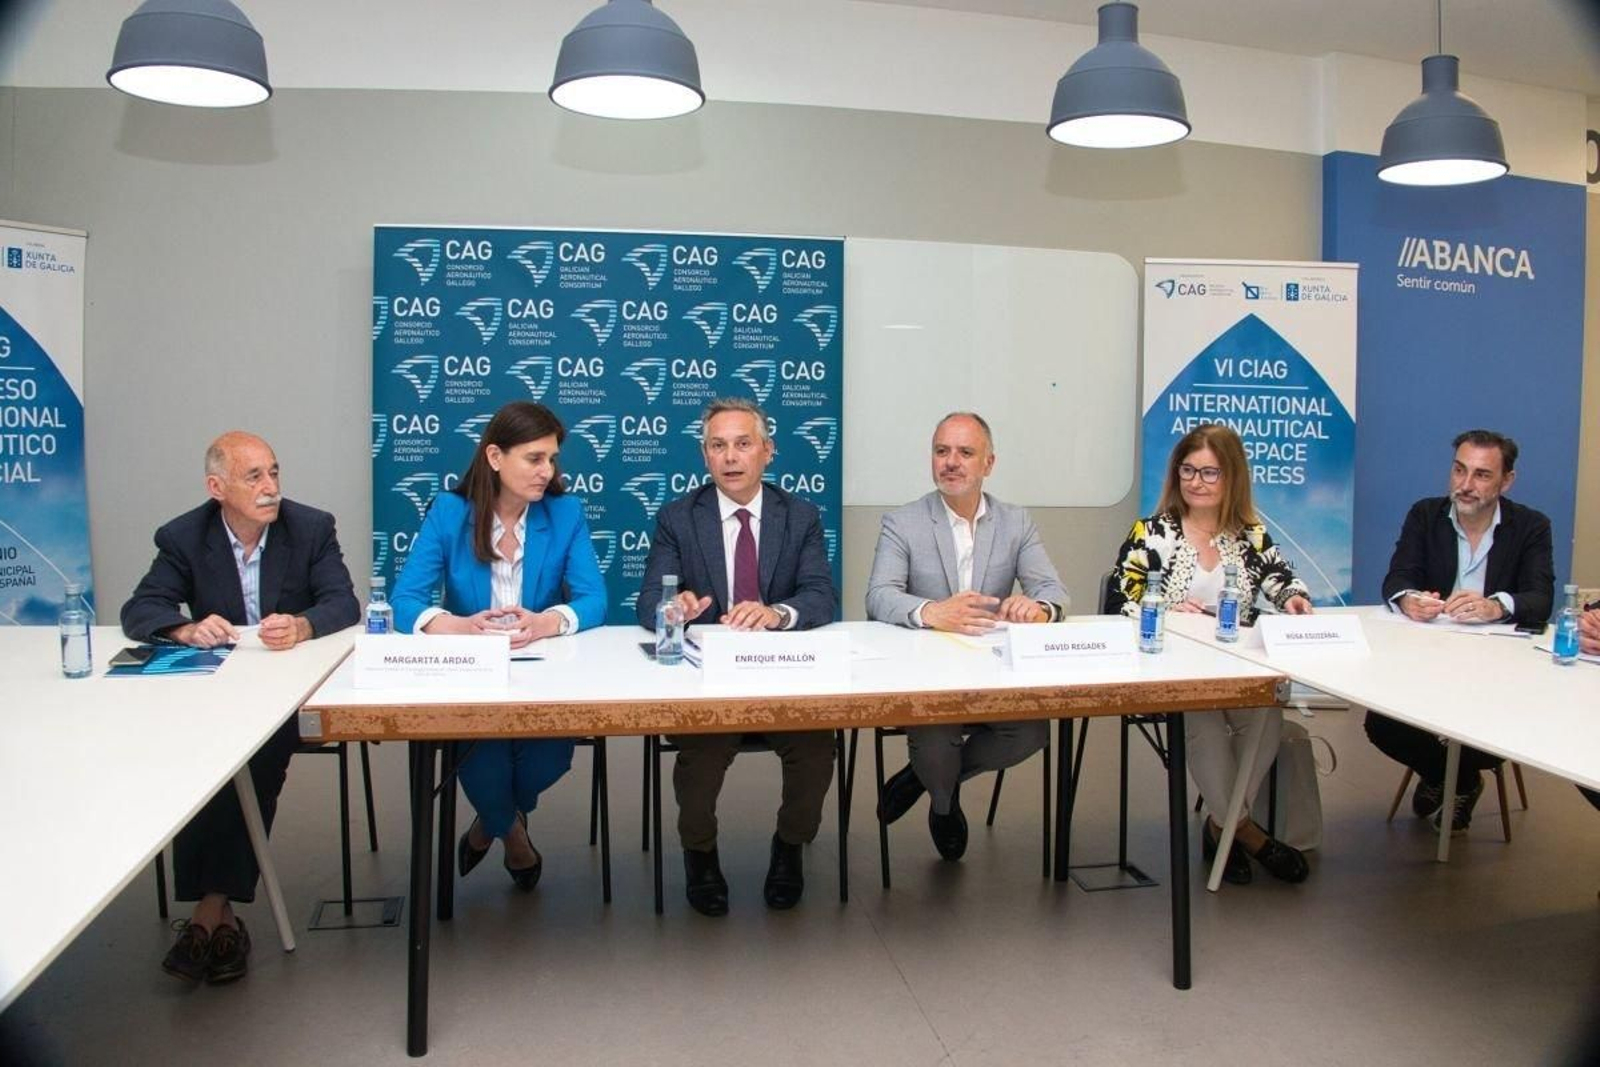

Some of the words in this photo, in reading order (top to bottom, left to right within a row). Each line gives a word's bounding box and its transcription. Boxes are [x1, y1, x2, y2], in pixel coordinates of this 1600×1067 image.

[26, 252, 56, 262] XUNTA
[446, 240, 492, 260] CAG
[559, 243, 605, 263] CAG
[673, 246, 718, 266] CAG
[25, 260, 38, 270] DE
[40, 262, 75, 274] GALICIA
[782, 251, 826, 269] CAG
[1178, 284, 1206, 296] CAG
[1302, 284, 1331, 294] XUNTA
[1396, 274, 1431, 290] Sentir
[1434, 278, 1476, 294] común
[1302, 293, 1312, 301] DE
[1314, 294, 1348, 302] GALICIA
[394, 298, 440, 317] CAG
[508, 299, 554, 319] CAG
[622, 301, 668, 321] CAG
[732, 304, 778, 323] CAG
[444, 356, 491, 376] CAG
[558, 358, 604, 377] CAG
[672, 359, 717, 379] CAG
[781, 361, 826, 380] CAG
[1214, 358, 1232, 378] VI
[1239, 359, 1288, 379] CIAG
[1169, 394, 1332, 416] INTERNATIONAL
[393, 415, 439, 434] CAG
[622, 416, 667, 435] CAG
[0, 461, 42, 484] IAL
[781, 474, 824, 493] CAG
[622, 530, 650, 550] CA
[1044, 644, 1070, 652] DAVID
[1072, 642, 1107, 651] REGADES
[384, 656, 440, 664] MARGARITA
[442, 656, 476, 665] ARDAO
[735, 654, 776, 664] ENRIQUE
[778, 653, 816, 663] MALLÓN
